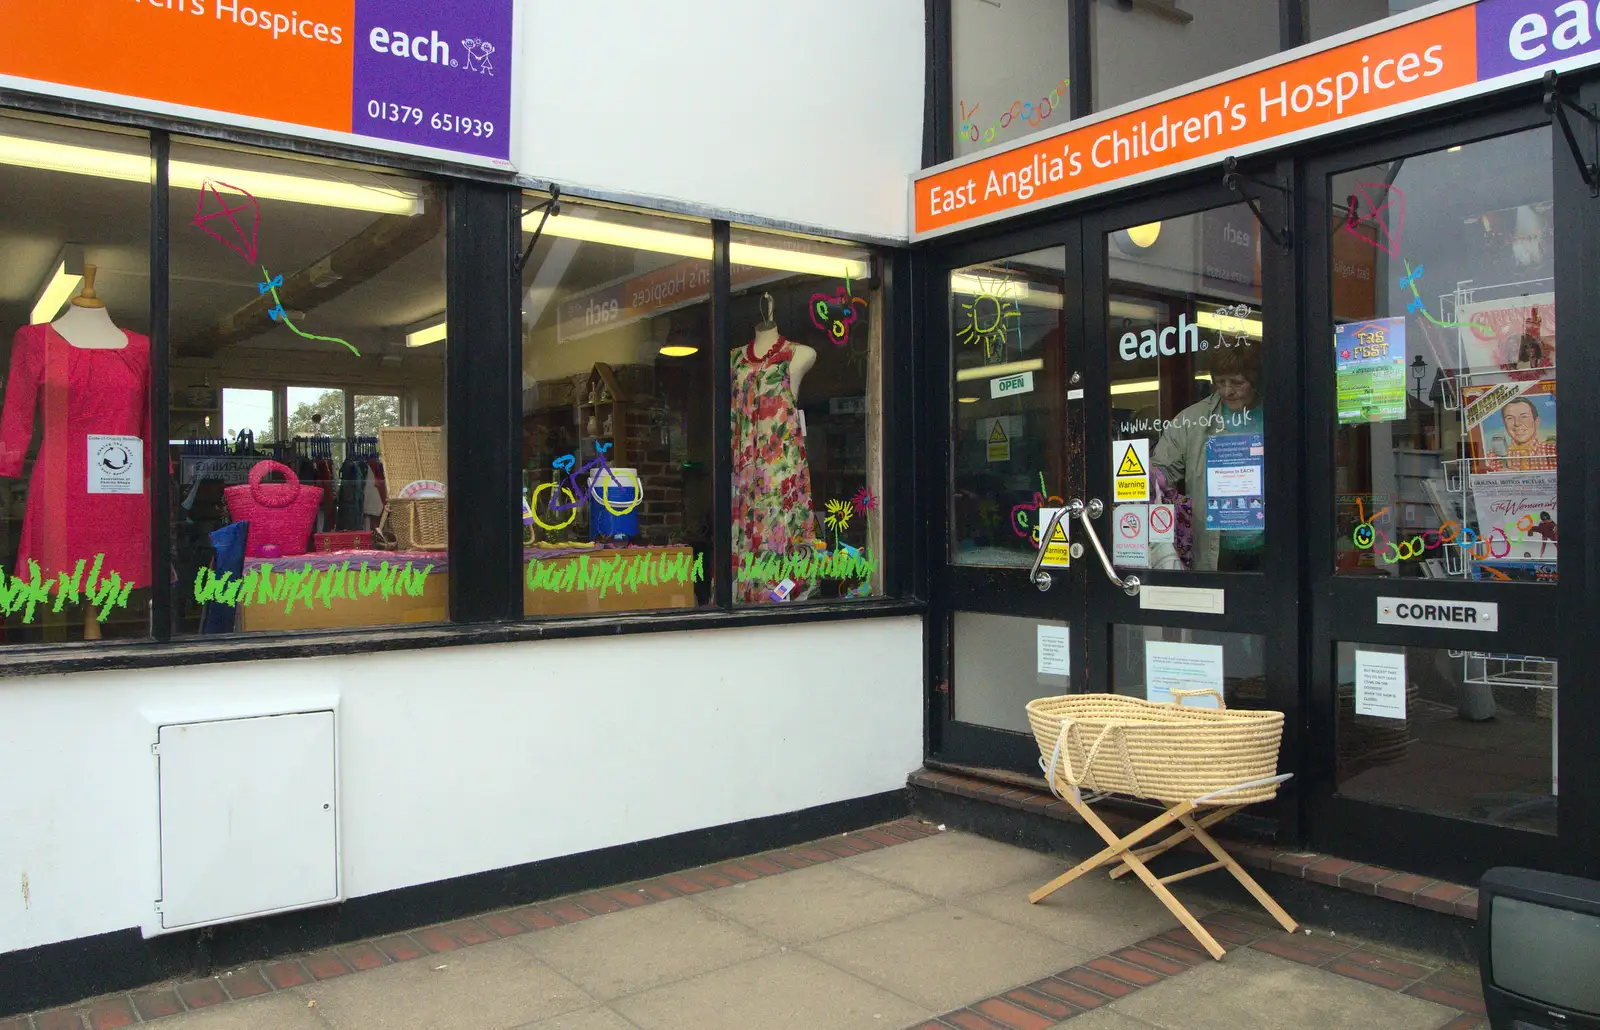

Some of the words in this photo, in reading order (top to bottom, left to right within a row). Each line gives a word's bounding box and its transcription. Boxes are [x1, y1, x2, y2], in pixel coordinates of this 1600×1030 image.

[215, 0, 343, 45] Hospices
[1508, 0, 1600, 61] ea
[367, 99, 423, 126] 01379
[430, 113, 495, 140] 651939
[928, 181, 976, 216] East
[983, 142, 1082, 201] Anglia's
[1091, 94, 1246, 169] Children's
[1259, 42, 1444, 119] Hospices
[998, 377, 1025, 392] OPEN
[1120, 405, 1253, 434] www.each.org.uk
[1118, 480, 1145, 490] Warning
[1396, 603, 1477, 623] CORNER
